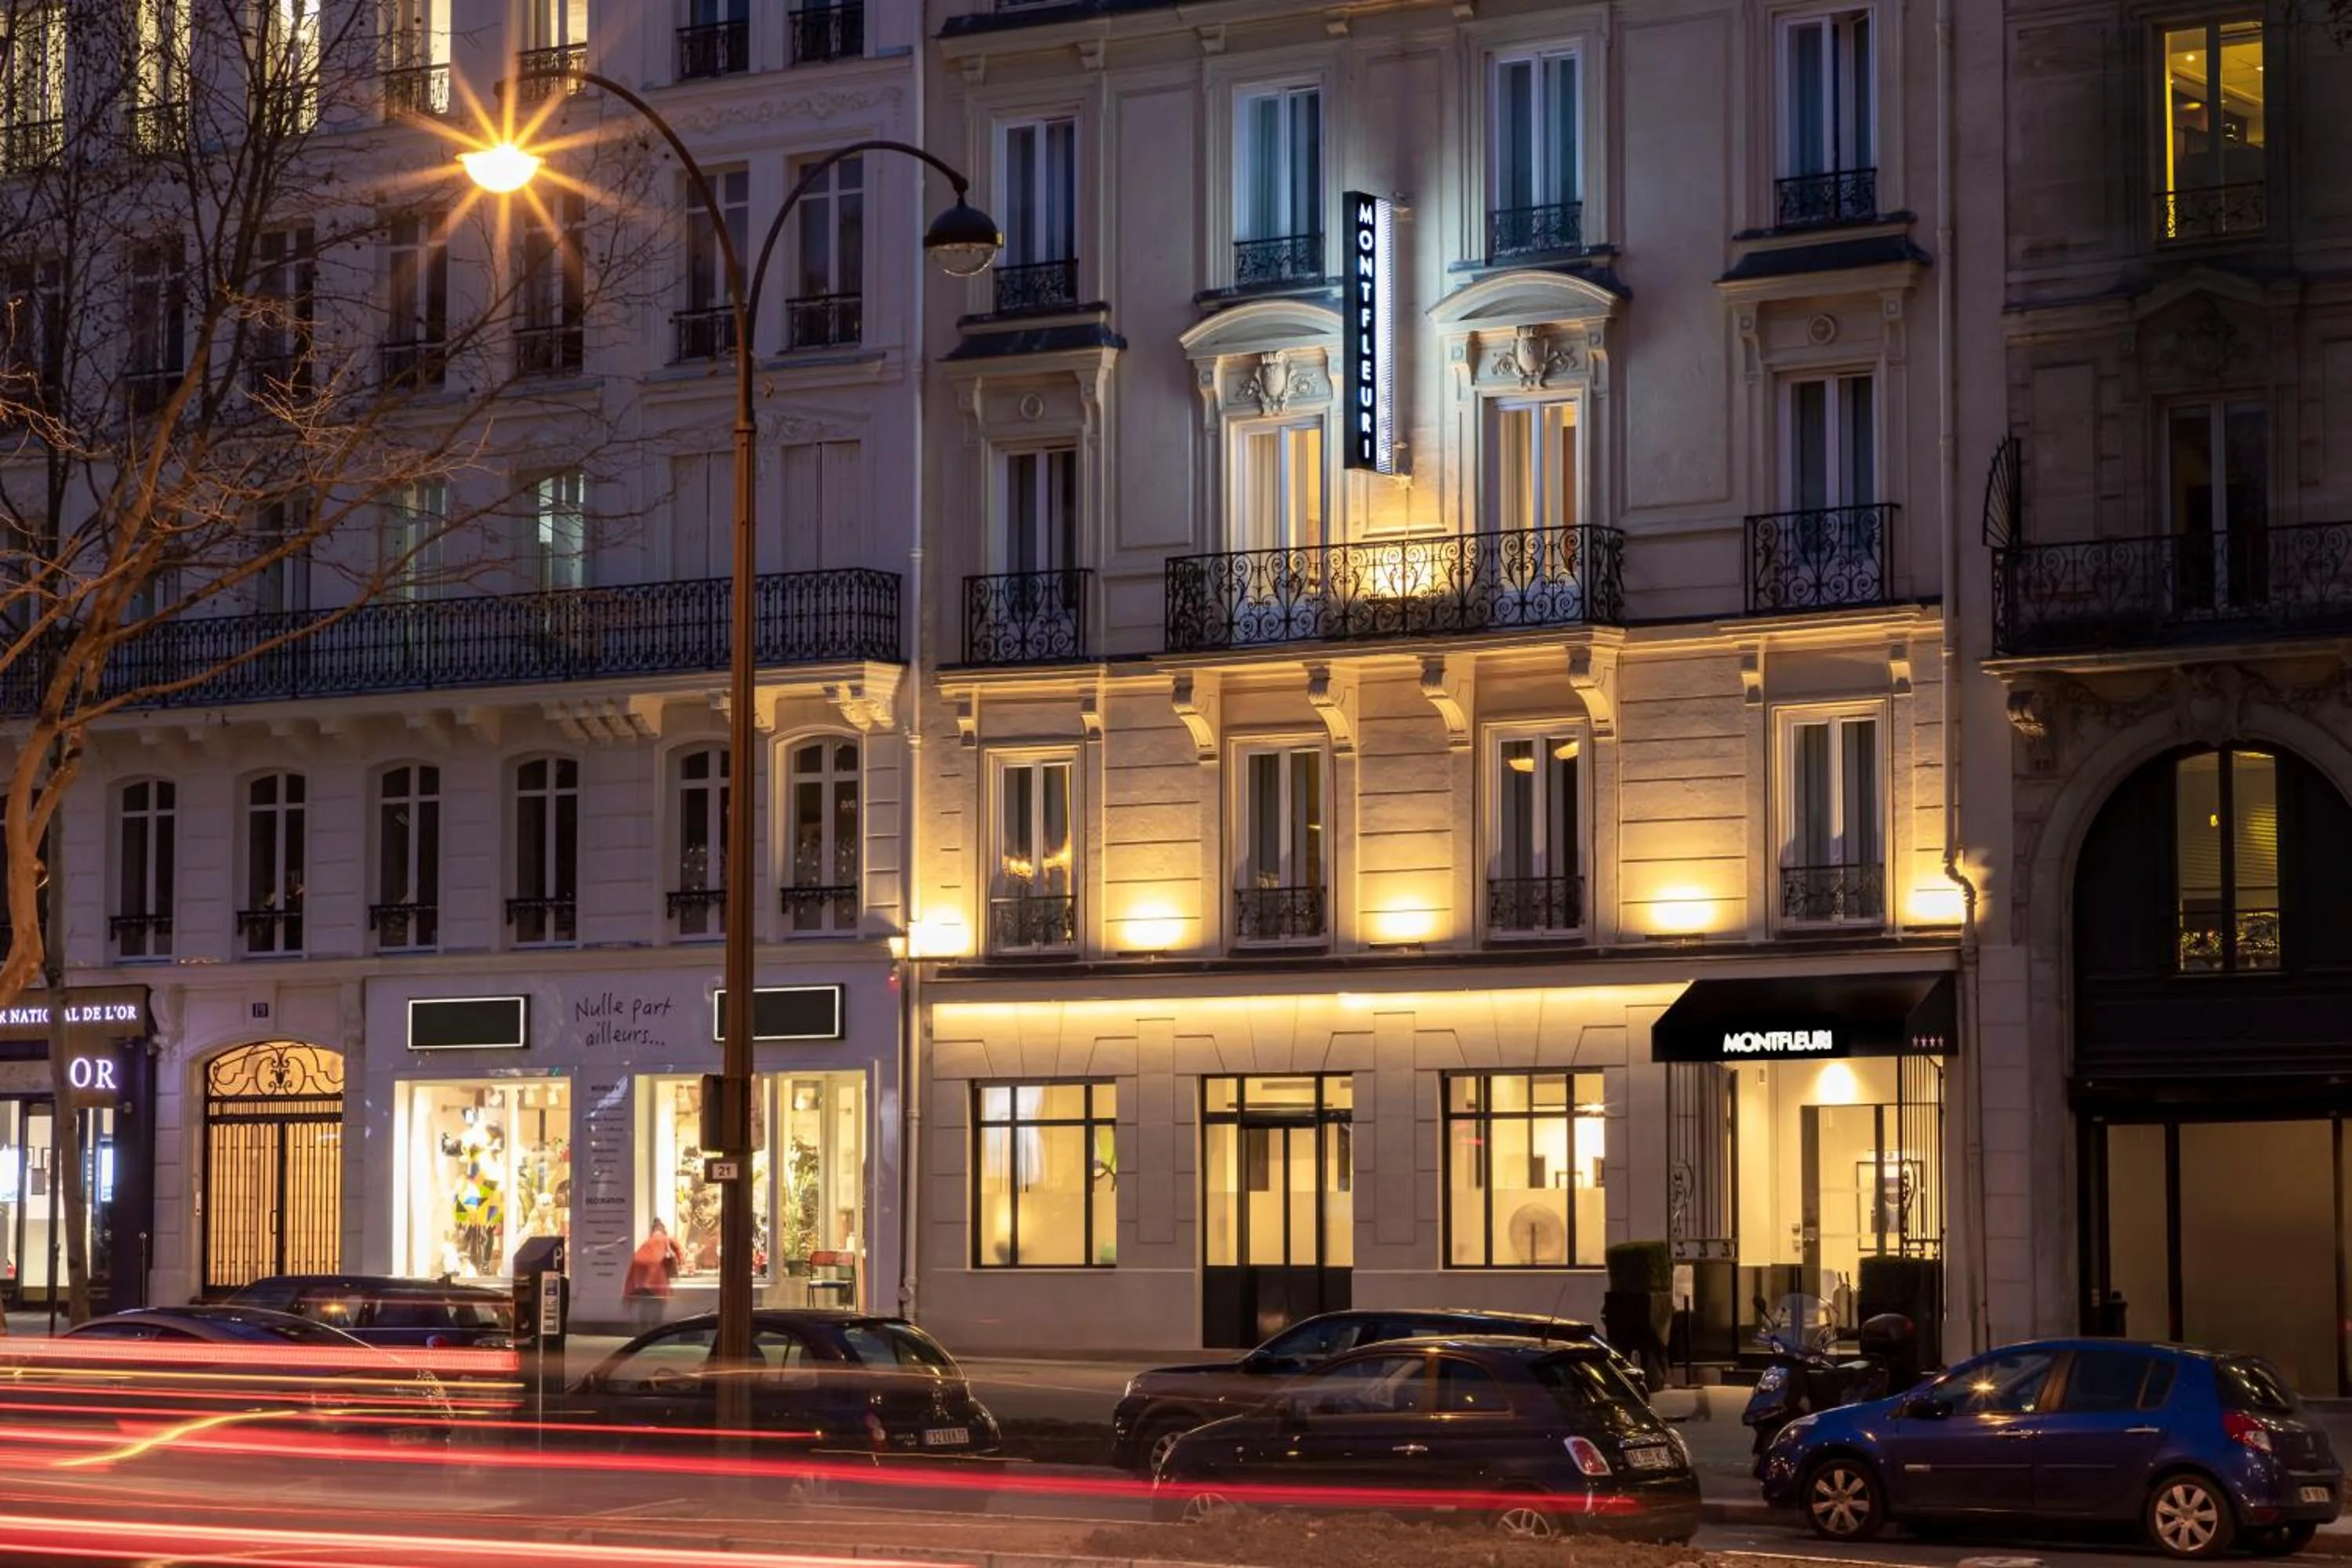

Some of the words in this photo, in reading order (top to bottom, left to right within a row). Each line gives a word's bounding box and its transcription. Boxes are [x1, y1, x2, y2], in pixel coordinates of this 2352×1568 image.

[1358, 201, 1374, 459] MONTFLEURI
[82, 1007, 101, 1020] DE
[105, 1005, 136, 1019] L'OR
[575, 992, 624, 1023] Nulle
[633, 996, 672, 1024] part
[1723, 1030, 1832, 1052] MONTFLEURI
[70, 1058, 117, 1089] OR
[718, 1166, 731, 1177] 21
[553, 1247, 563, 1269] P
